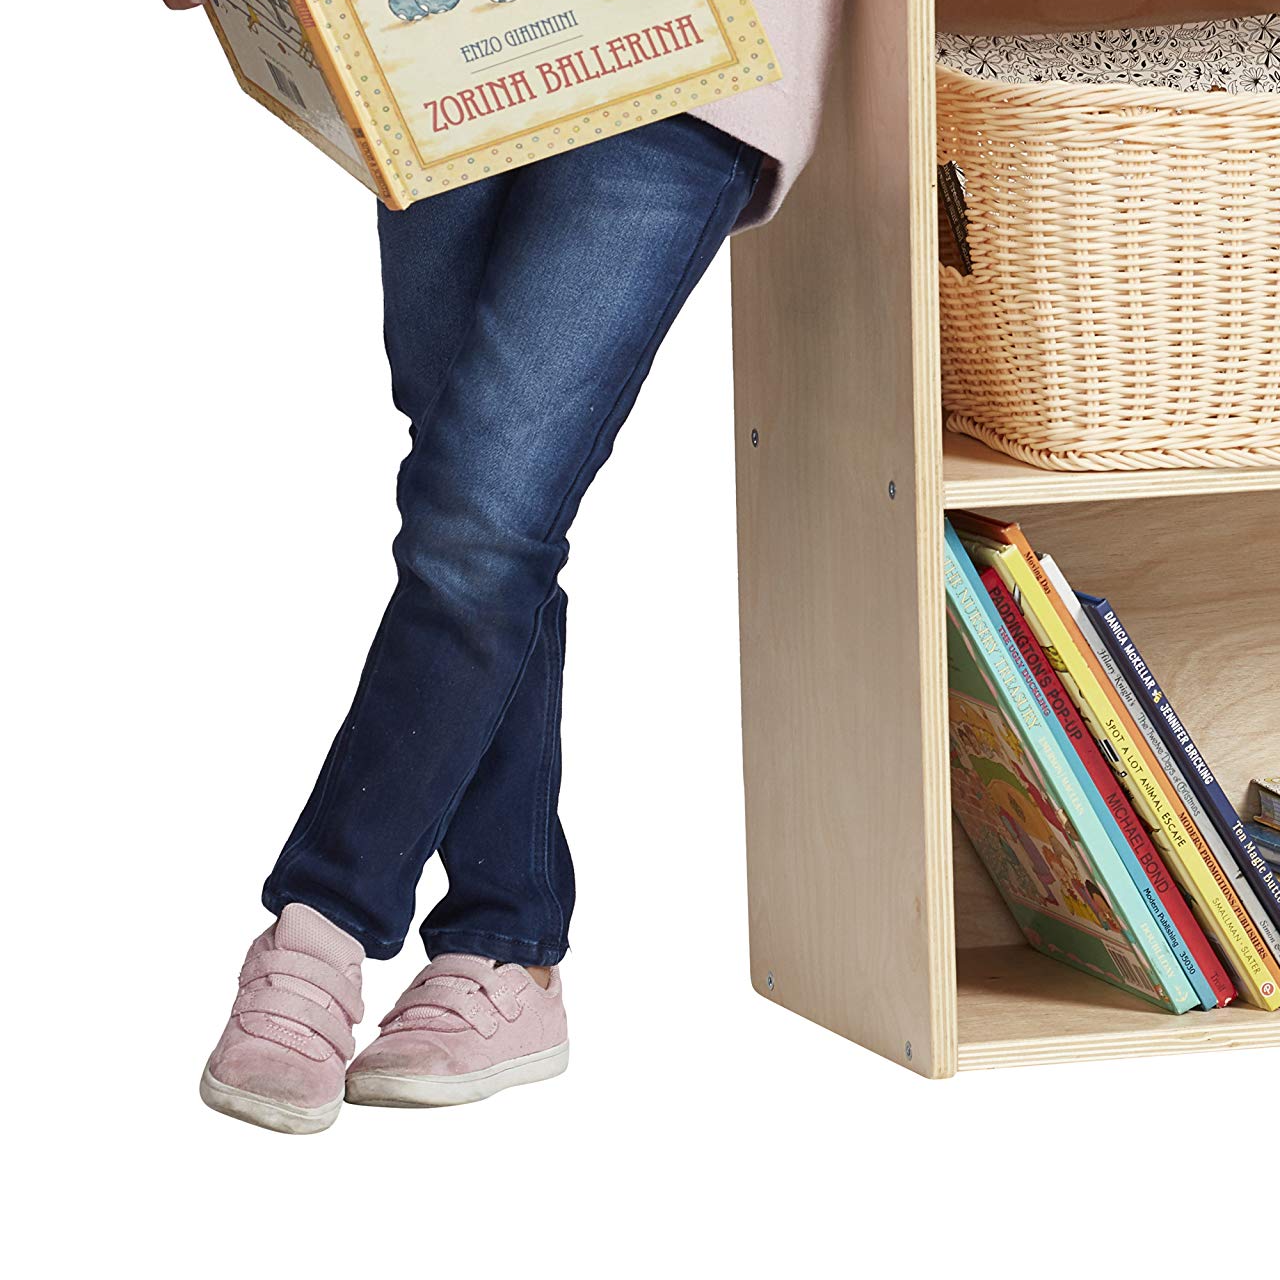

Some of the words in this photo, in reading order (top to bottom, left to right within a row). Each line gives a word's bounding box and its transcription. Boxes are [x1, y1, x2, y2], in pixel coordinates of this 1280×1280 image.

[423, 70, 537, 133] ZORINA
[535, 14, 704, 95] BALLERINA
[460, 35, 503, 63] ENZO
[504, 10, 579, 47] GIANNINI
[1023, 551, 1043, 584] Moving
[1041, 579, 1052, 595] Day
[944, 558, 964, 589] THE
[956, 588, 1001, 655] NURSERY
[993, 656, 1042, 730] TREASURY
[989, 586, 1053, 688] PADDINGTON'S
[1047, 689, 1083, 740] POP-UP
[1103, 611, 1128, 646] DANICA
[998, 625, 1011, 645] THE
[1008, 645, 1025, 668] UGLY
[1021, 667, 1051, 717] DUCKLING
[1097, 648, 1116, 675] Hilary
[1114, 673, 1135, 707] Knight's
[1105, 719, 1125, 743] SPOT
[1121, 747, 1130, 755] A
[1127, 755, 1144, 774] LOT
[1140, 777, 1163, 812] ANIMAL
[1161, 812, 1187, 848] ESCAPE
[1138, 711, 1148, 730] The
[1148, 727, 1164, 755] Twelve
[1161, 752, 1175, 776] Days
[1177, 781, 1201, 817] Christmas
[1159, 703, 1190, 747] JENNIFER
[1184, 744, 1214, 785] BRICKING
[1107, 792, 1143, 855] MICHAEL
[1138, 851, 1169, 895] BOND
[1178, 812, 1205, 851] MODERN
[1232, 820, 1248, 843] Ten
[1243, 841, 1267, 874] Magic
[1143, 887, 1160, 914] Modern
[1157, 912, 1179, 948] Publishing
[1180, 951, 1196, 975] 35030
[1211, 897, 1241, 943] SMALLMAN
[1240, 946, 1262, 975] SLATER
[1260, 920, 1277, 945] Simon
[1210, 972, 1227, 993] Troll
